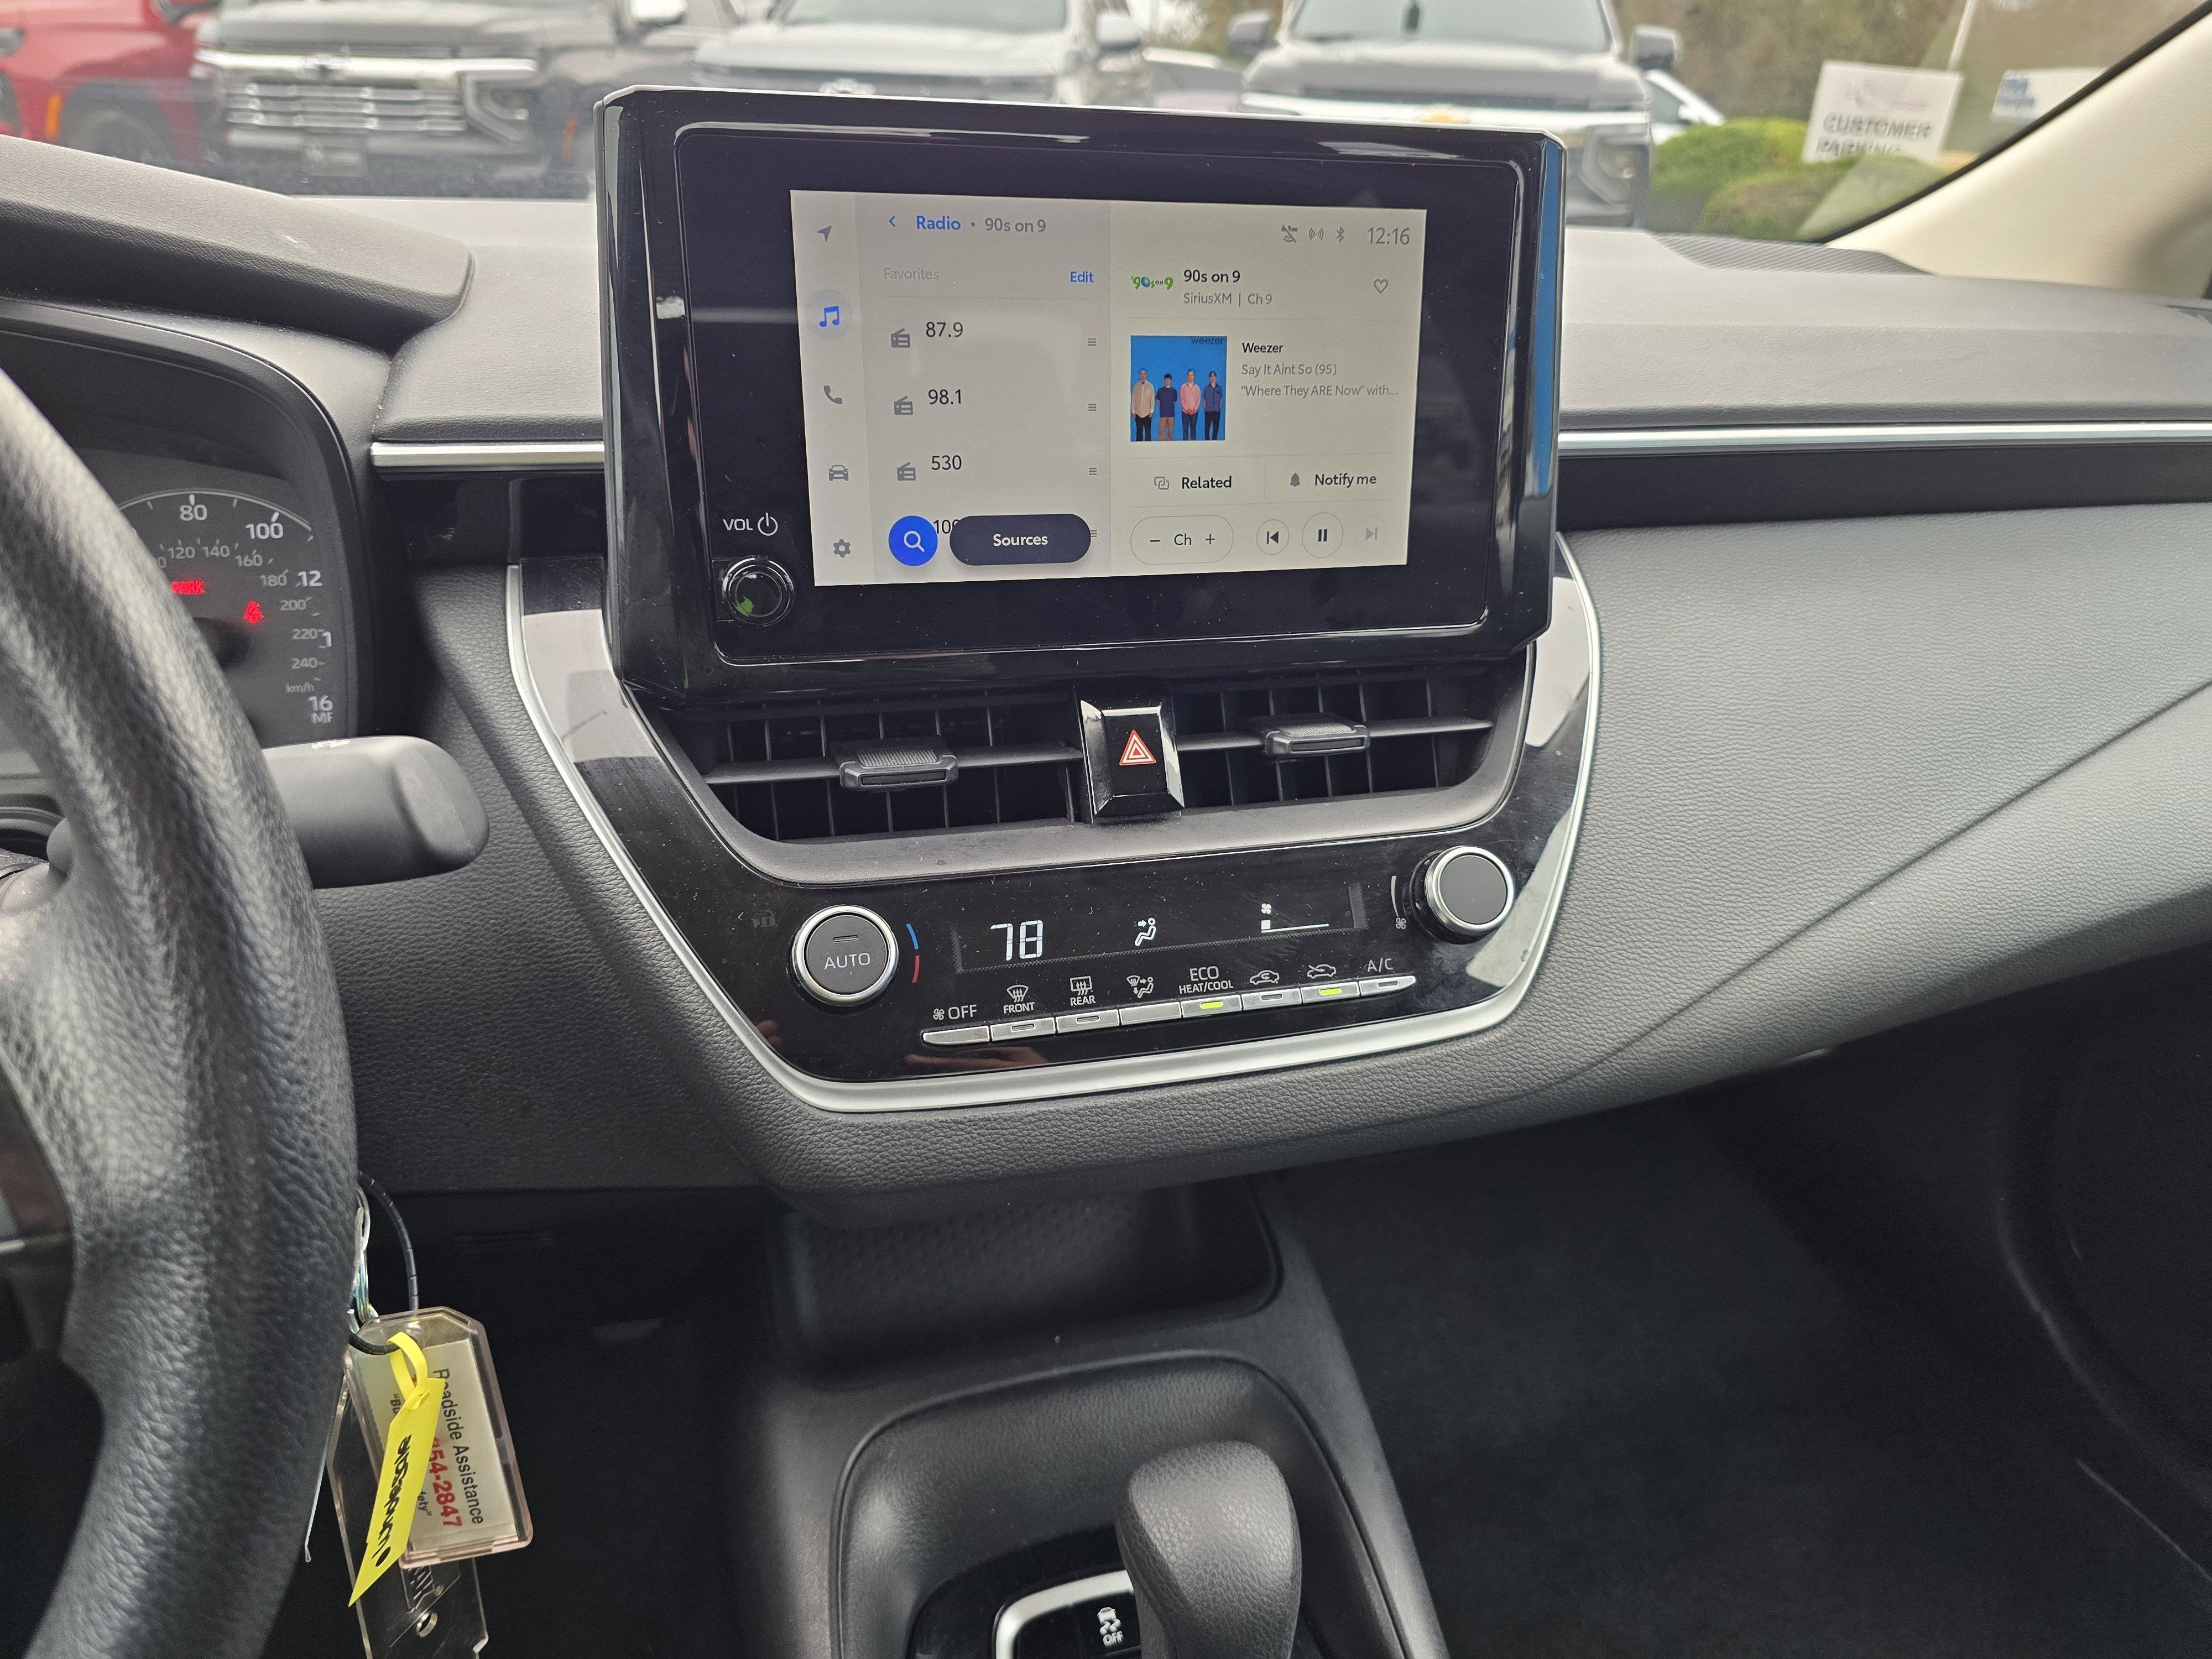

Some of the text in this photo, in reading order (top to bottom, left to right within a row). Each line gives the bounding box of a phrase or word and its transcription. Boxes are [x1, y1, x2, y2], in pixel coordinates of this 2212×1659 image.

[1823, 112, 1934, 139] CUSTOMER
[916, 216, 961, 231] Radio
[984, 217, 1046, 233] 90s on 9
[1367, 226, 1411, 246] 12:16
[884, 268, 940, 280] Favorites
[1070, 271, 1094, 284] Edit
[1183, 269, 1241, 283] 90s on 9
[1183, 293, 1232, 305] SiriusXM
[1247, 293, 1263, 305] Ch
[1265, 294, 1272, 305] 9
[925, 321, 963, 338] 87.9
[1242, 342, 1283, 353] Weezer
[1241, 363, 1337, 377] Say It Aint So (95)
[927, 389, 963, 405] 98.1
[1241, 385, 1281, 396] "Where
[1284, 385, 1308, 398] They
[1311, 385, 1333, 396] ARE
[931, 455, 962, 471] 530
[1181, 476, 1232, 489] Related
[1314, 473, 1377, 487] Notify me
[179, 504, 207, 521] 80
[245, 522, 284, 540] 100
[723, 518, 753, 531] VOL
[993, 533, 1048, 547] Sources
[1173, 534, 1192, 546] Ch
[168, 546, 195, 559] 120
[202, 545, 230, 557] 140
[236, 554, 263, 567] 160
[259, 573, 288, 587] 180
[297, 570, 323, 587] 12
[171, 580, 205, 594] PARK
[280, 599, 306, 611] 200
[291, 628, 318, 640] 220
[291, 657, 317, 669] 240
[285, 682, 315, 693] km/h
[309, 695, 333, 711] 16
[990, 919, 1044, 961] 78
[823, 952, 871, 971] AUTO
[1366, 958, 1394, 973] A/C
[1189, 966, 1219, 982] ECO
[1178, 980, 1234, 994] HEAT/COOL
[1070, 994, 1096, 1006] REAR
[948, 1004, 978, 1020] OFF
[1003, 1001, 1035, 1014] FRONT
[453, 1446, 484, 1525] Assistance
